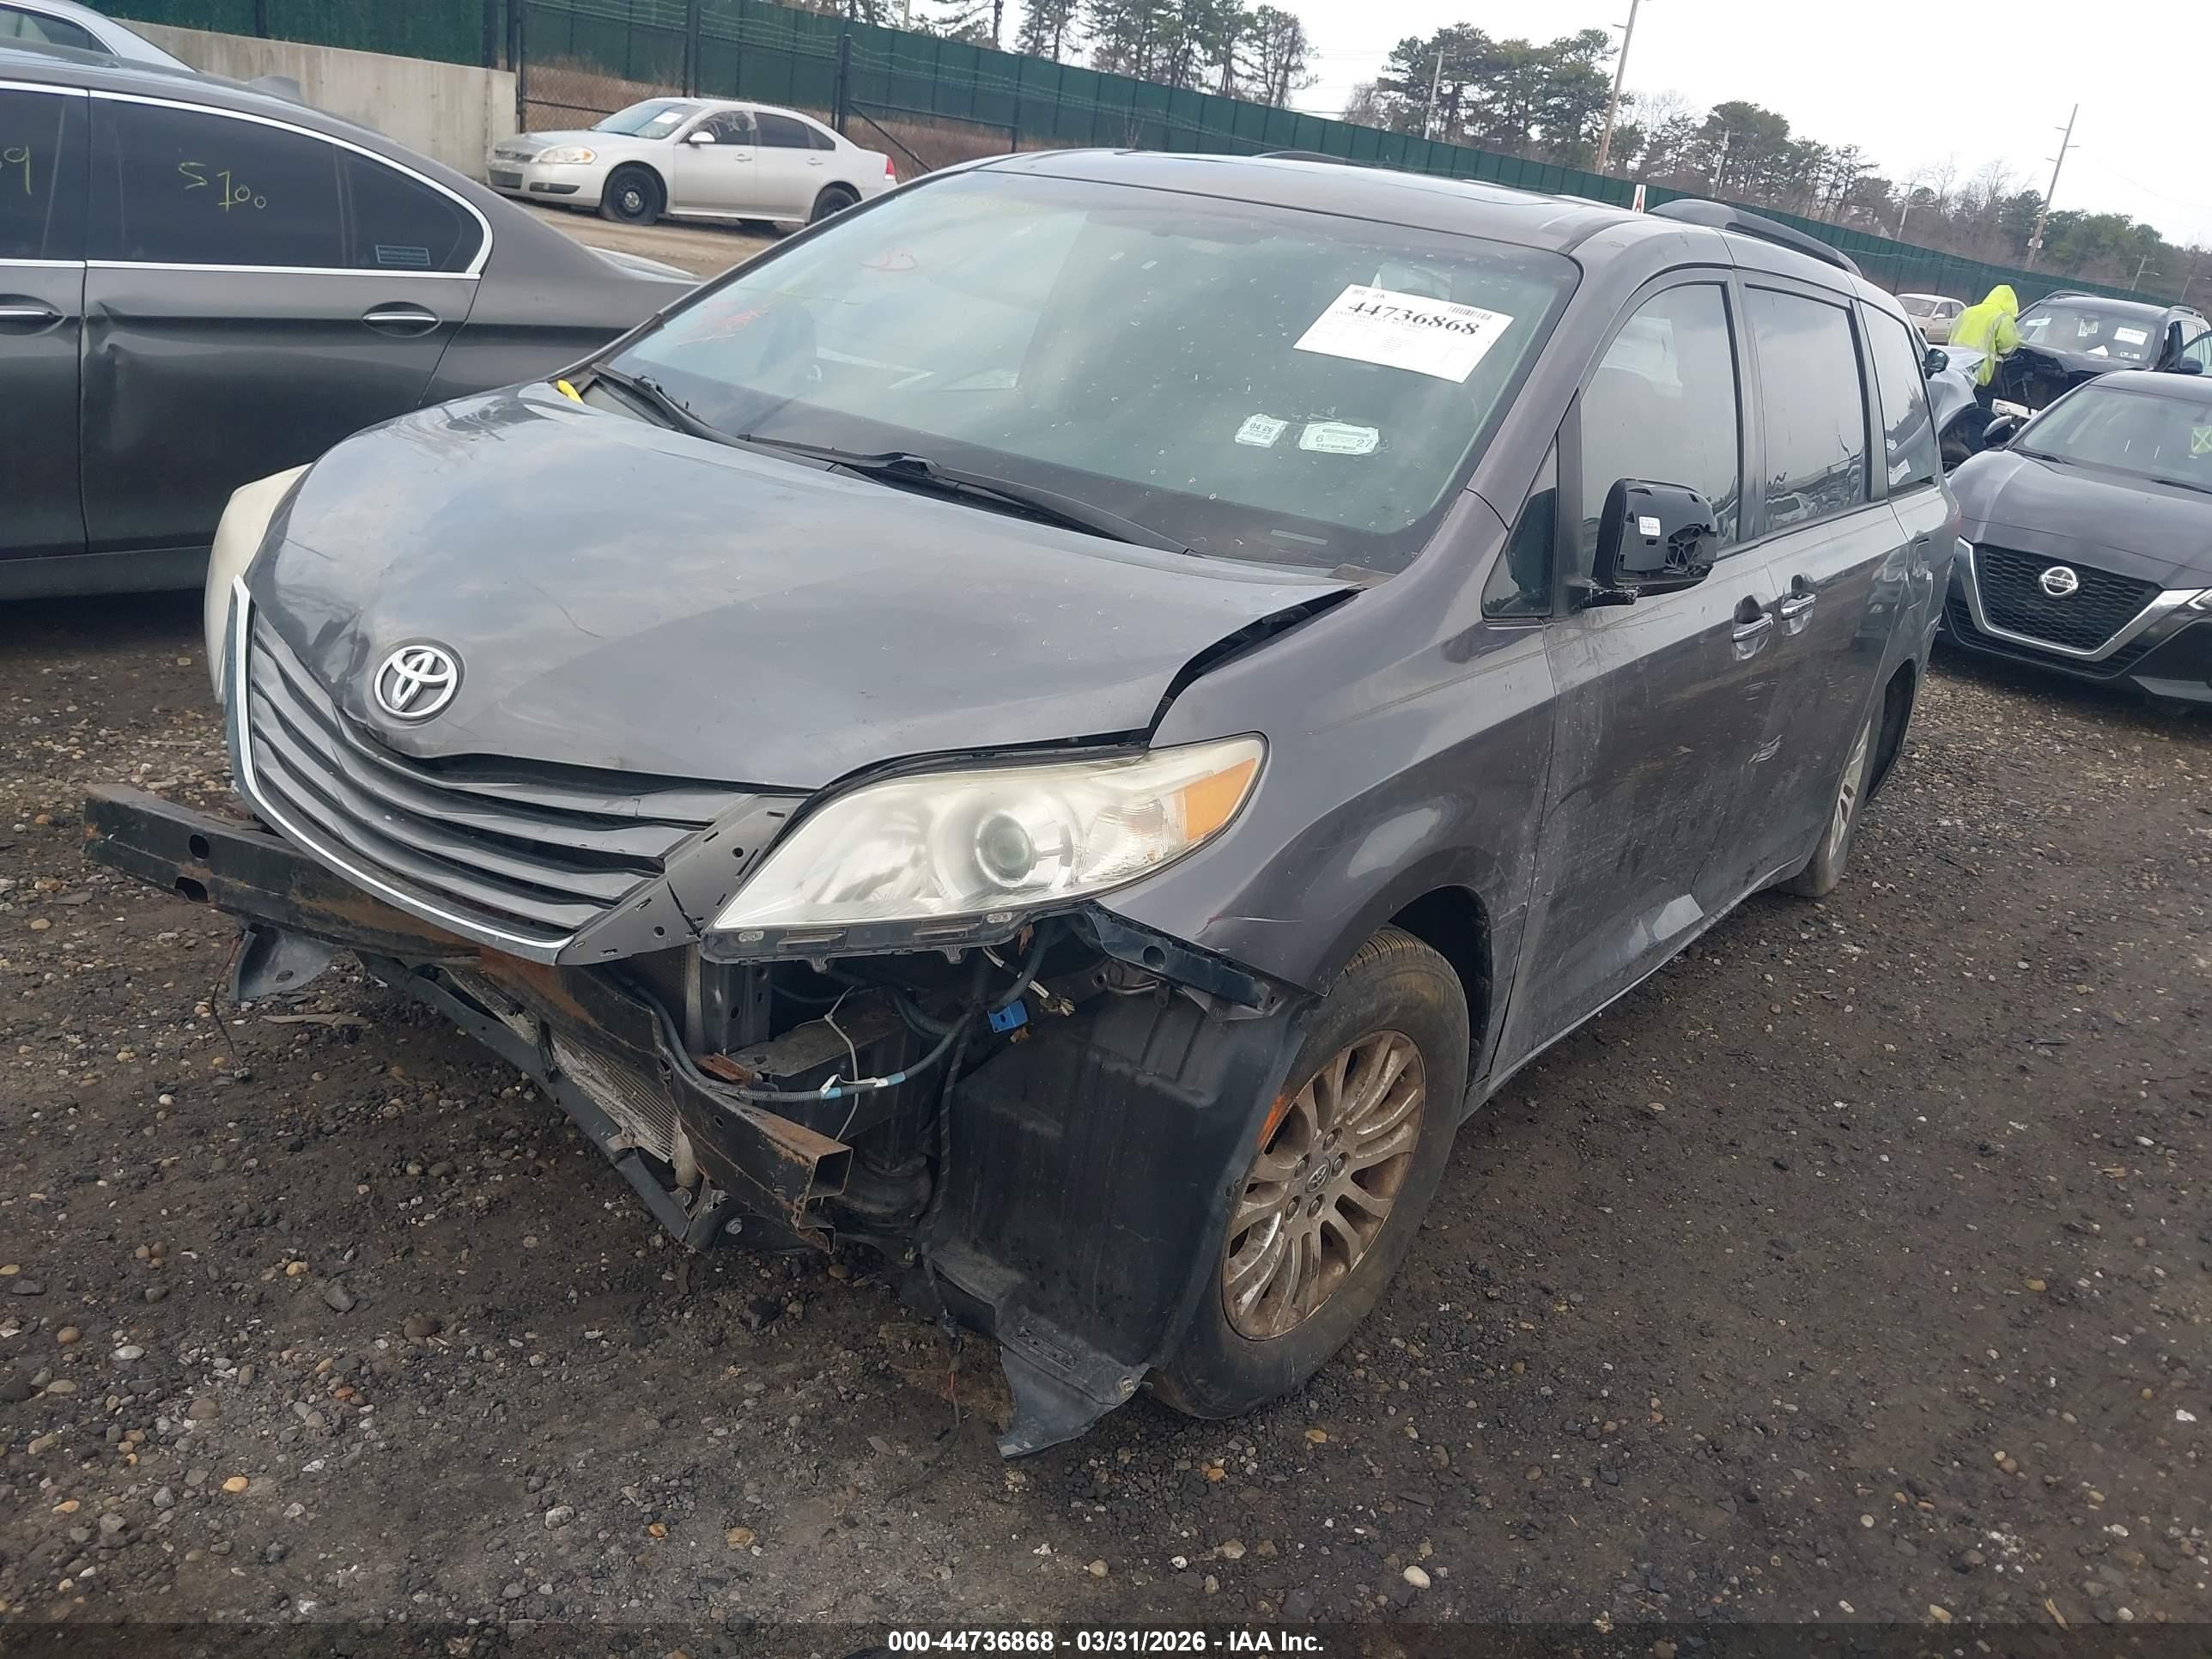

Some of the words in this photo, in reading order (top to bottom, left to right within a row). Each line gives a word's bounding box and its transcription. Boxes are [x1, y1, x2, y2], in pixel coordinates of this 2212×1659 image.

[1348, 301, 1480, 335] 44736868
[1357, 439, 1374, 447] 27
[2044, 576, 2074, 587] NISSAN
